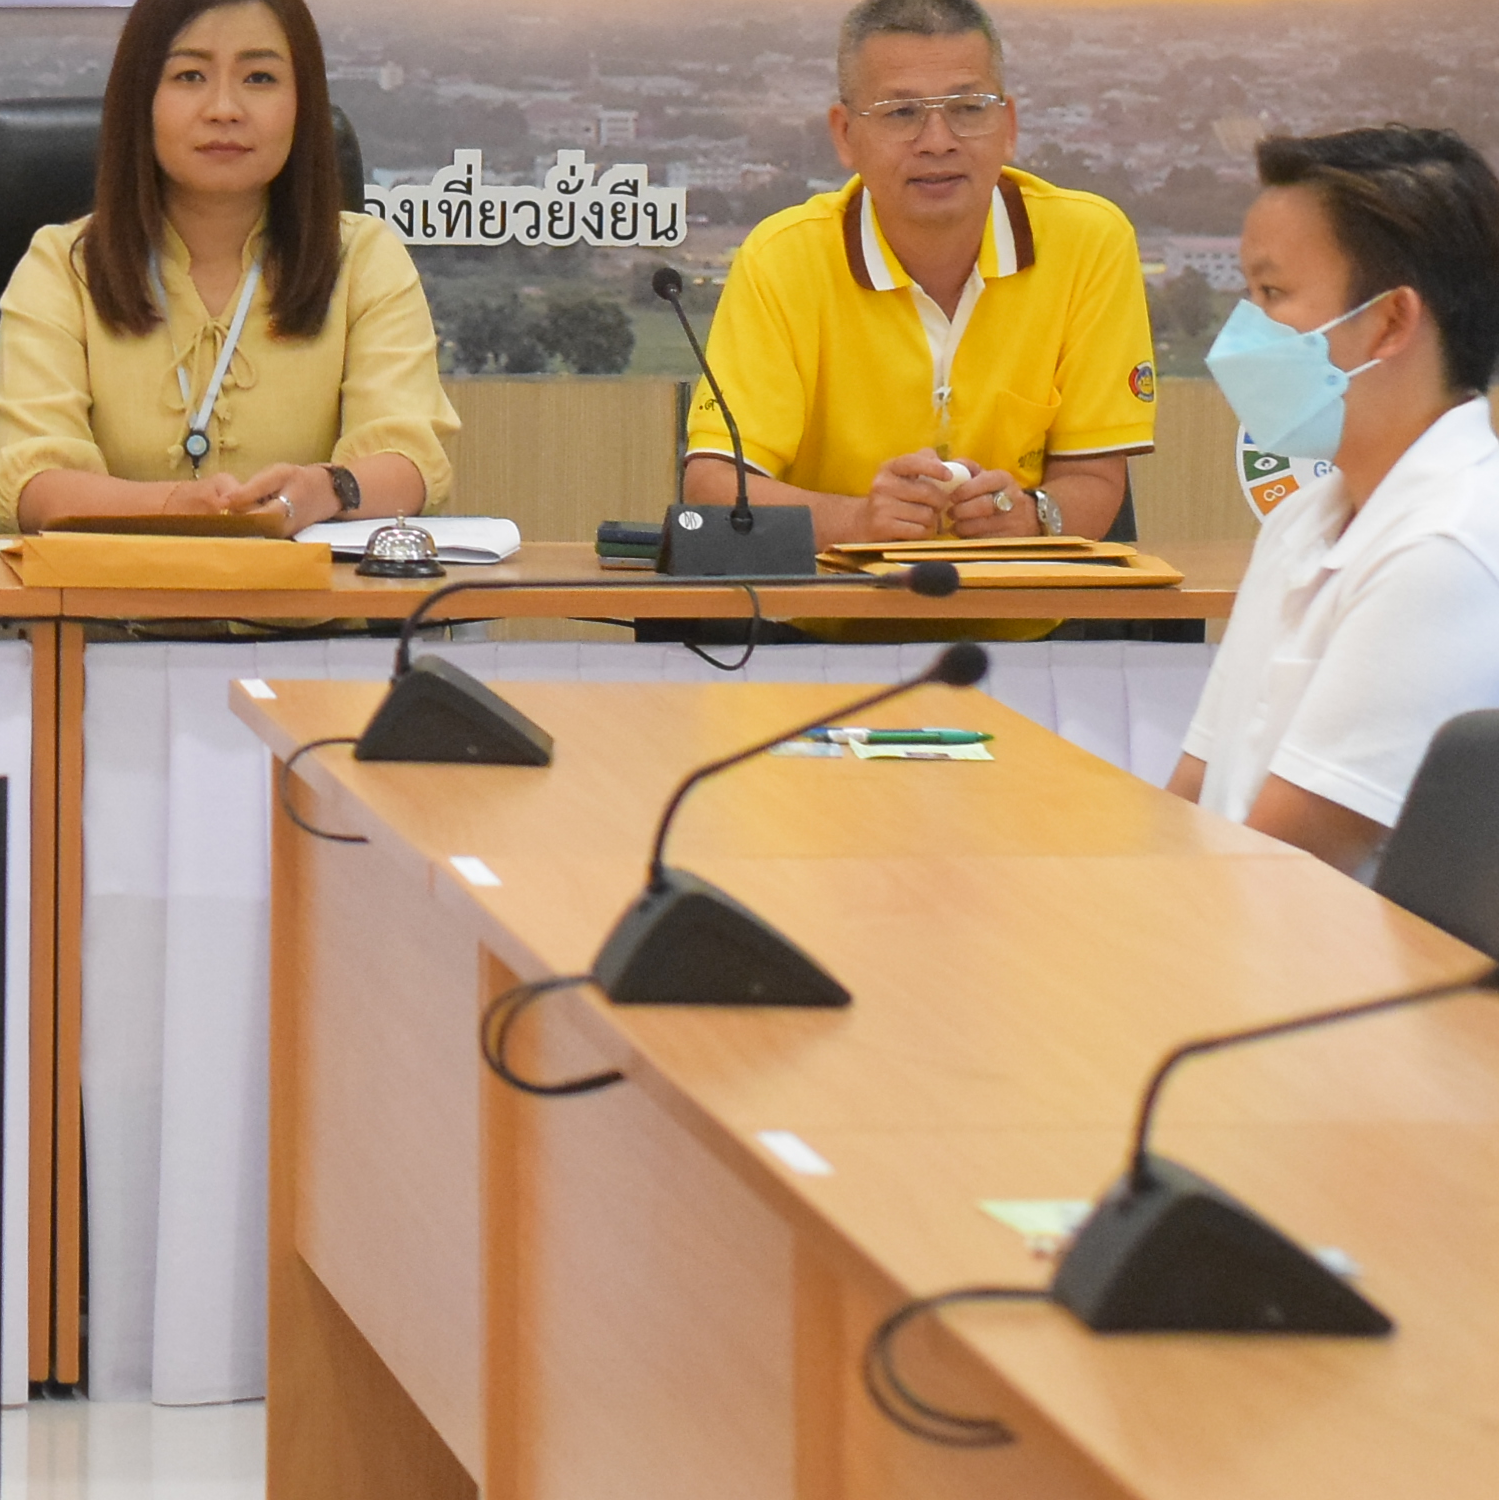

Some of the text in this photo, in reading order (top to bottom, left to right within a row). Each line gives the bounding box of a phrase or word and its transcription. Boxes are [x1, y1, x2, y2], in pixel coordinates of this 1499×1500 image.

[364, 163, 679, 241] งเที่ยวยั่งยืน
